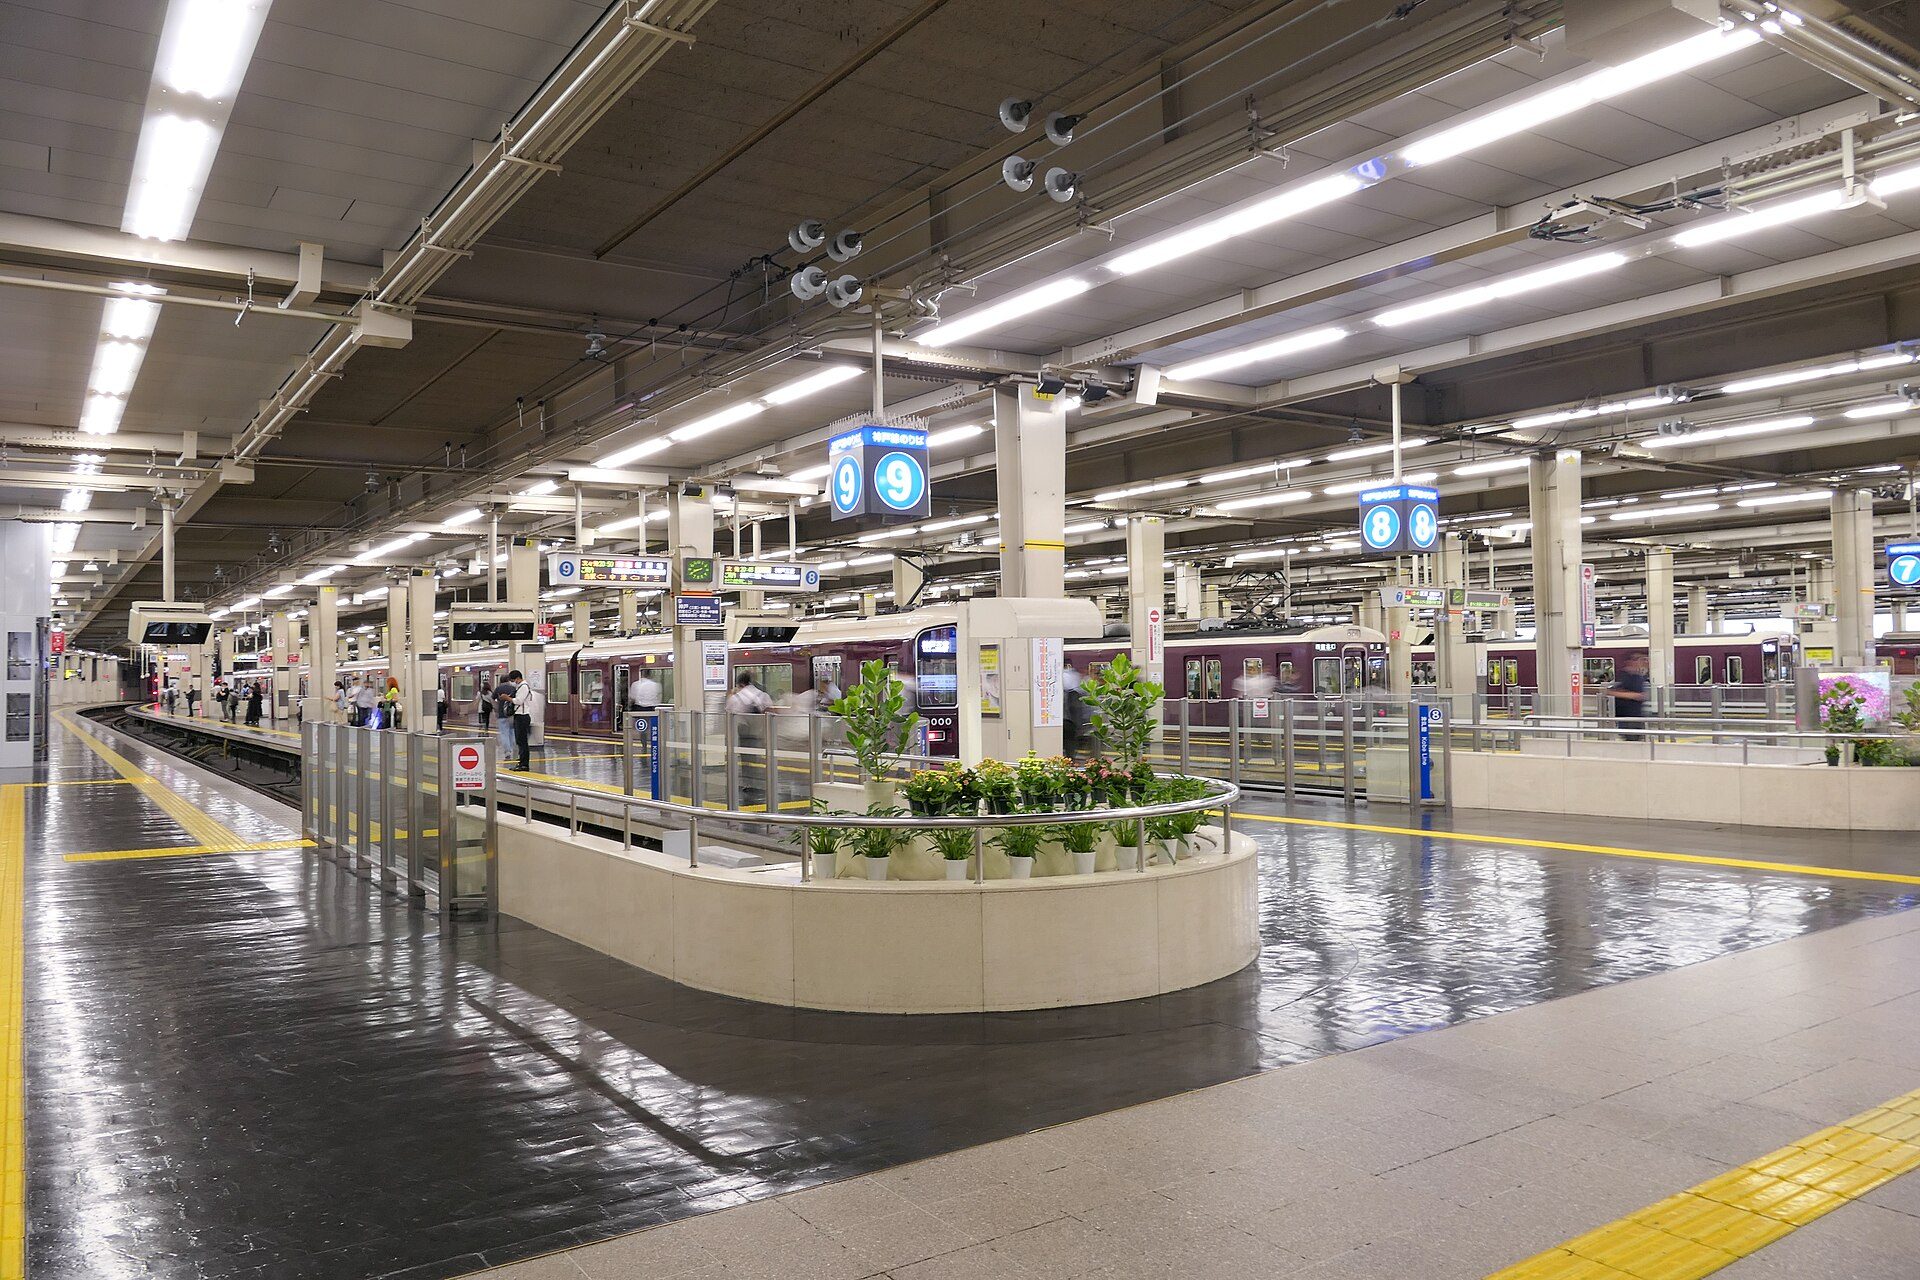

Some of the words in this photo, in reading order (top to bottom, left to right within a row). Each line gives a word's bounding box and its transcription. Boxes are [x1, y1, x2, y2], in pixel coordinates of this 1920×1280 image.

[839, 463, 855, 505] 9
[886, 460, 912, 502] 9
[1372, 511, 1391, 542] 8
[1415, 511, 1429, 542] 8
[1898, 560, 1916, 581] 7
